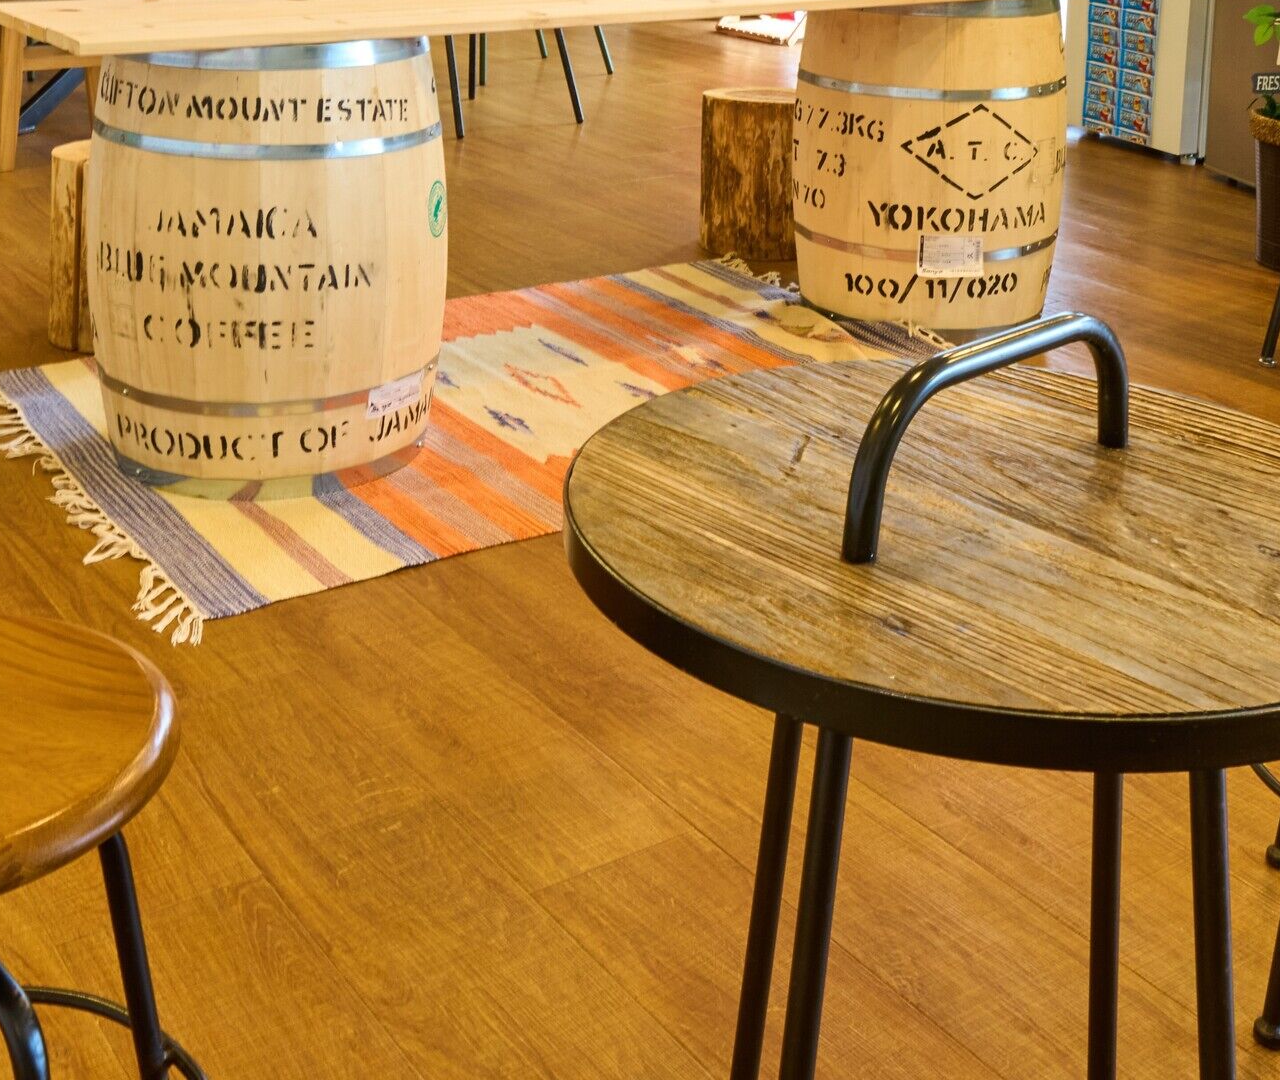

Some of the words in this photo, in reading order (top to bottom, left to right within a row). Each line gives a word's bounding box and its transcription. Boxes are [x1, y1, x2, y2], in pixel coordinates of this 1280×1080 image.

[186, 94, 309, 123] MOUNT
[317, 97, 410, 123] ESTATE
[816, 149, 847, 177] 7.3
[153, 206, 318, 239] JAMAICA
[867, 200, 1046, 234] YOKOHAMA
[99, 240, 166, 292] BLUE
[178, 260, 375, 294] MOUNTAIN
[844, 272, 1019, 304] 100/11/020
[142, 313, 317, 350] COFFEE
[117, 411, 285, 461] PRODUCT
[300, 420, 349, 453] OF
